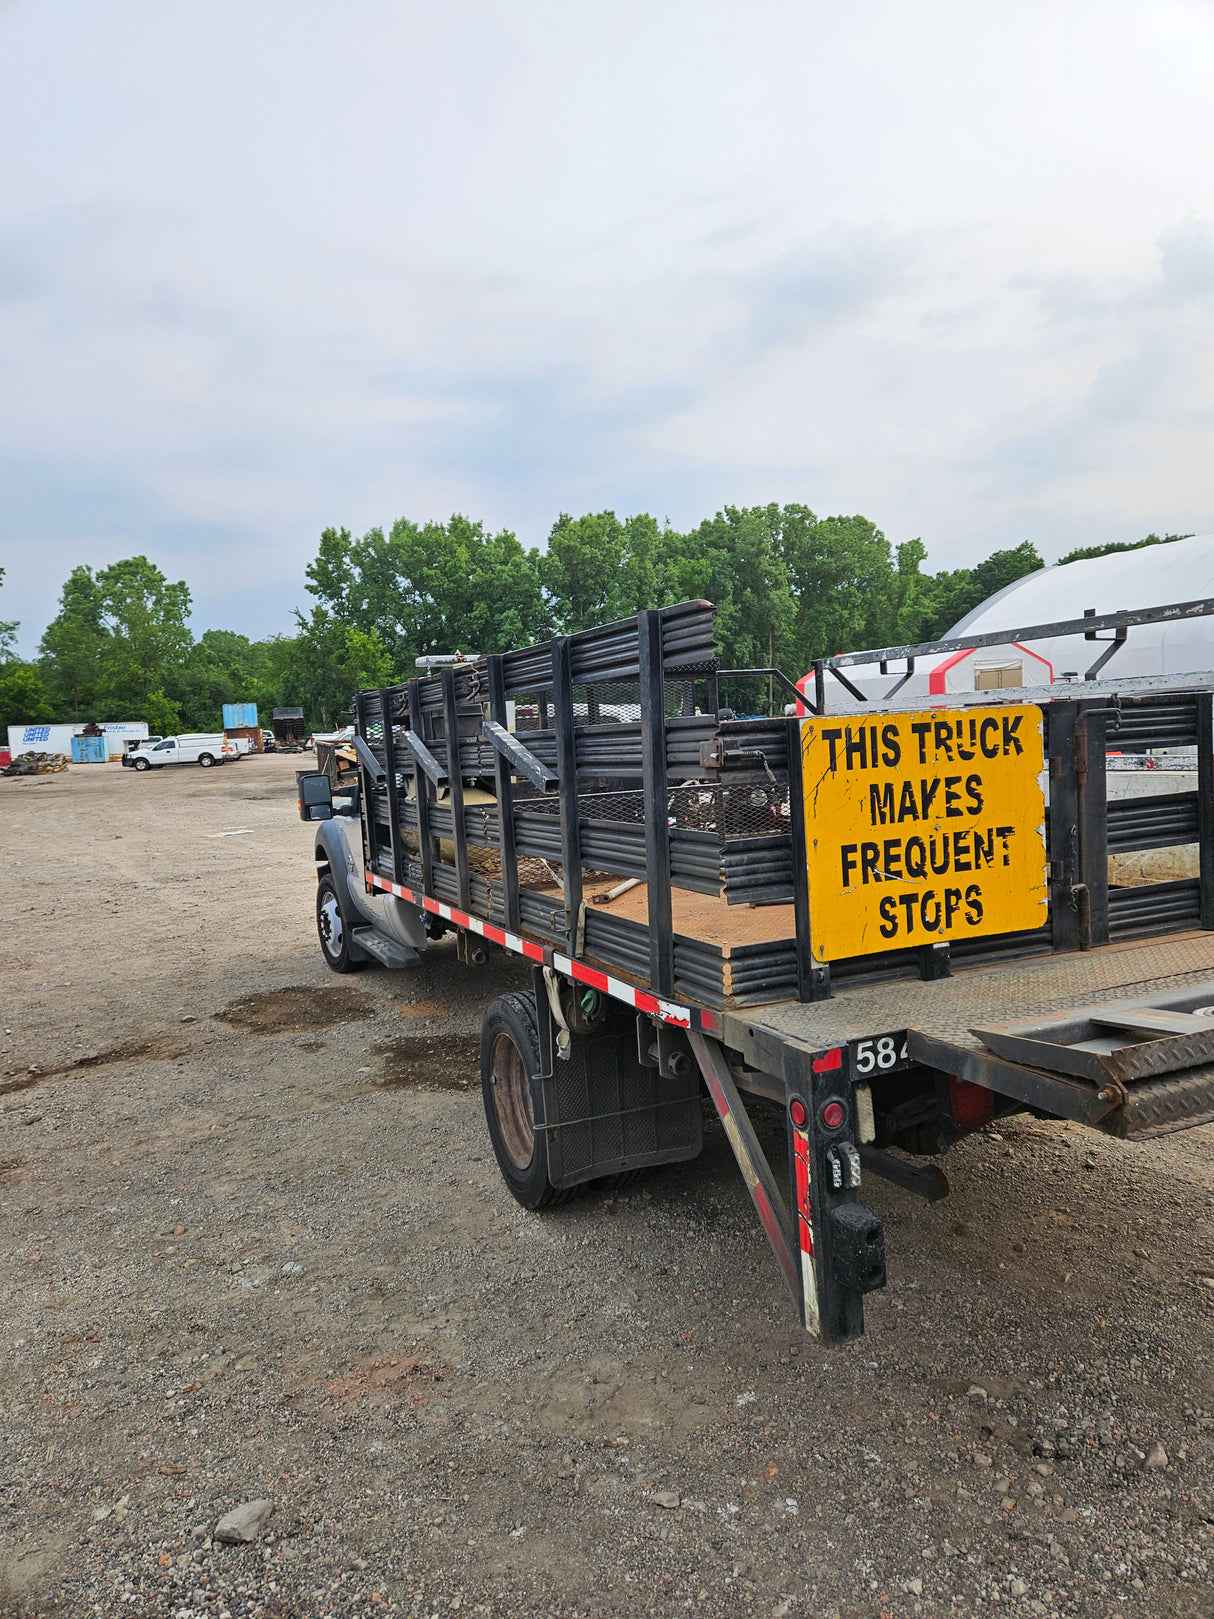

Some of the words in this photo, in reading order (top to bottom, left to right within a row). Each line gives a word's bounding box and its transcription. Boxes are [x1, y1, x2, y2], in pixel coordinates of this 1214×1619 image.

[822, 724, 901, 772] THIS
[911, 715, 1024, 764] TRUCK
[869, 774, 984, 826] MAKES
[840, 826, 1016, 888] FREQUENT
[879, 884, 984, 939] STOPS
